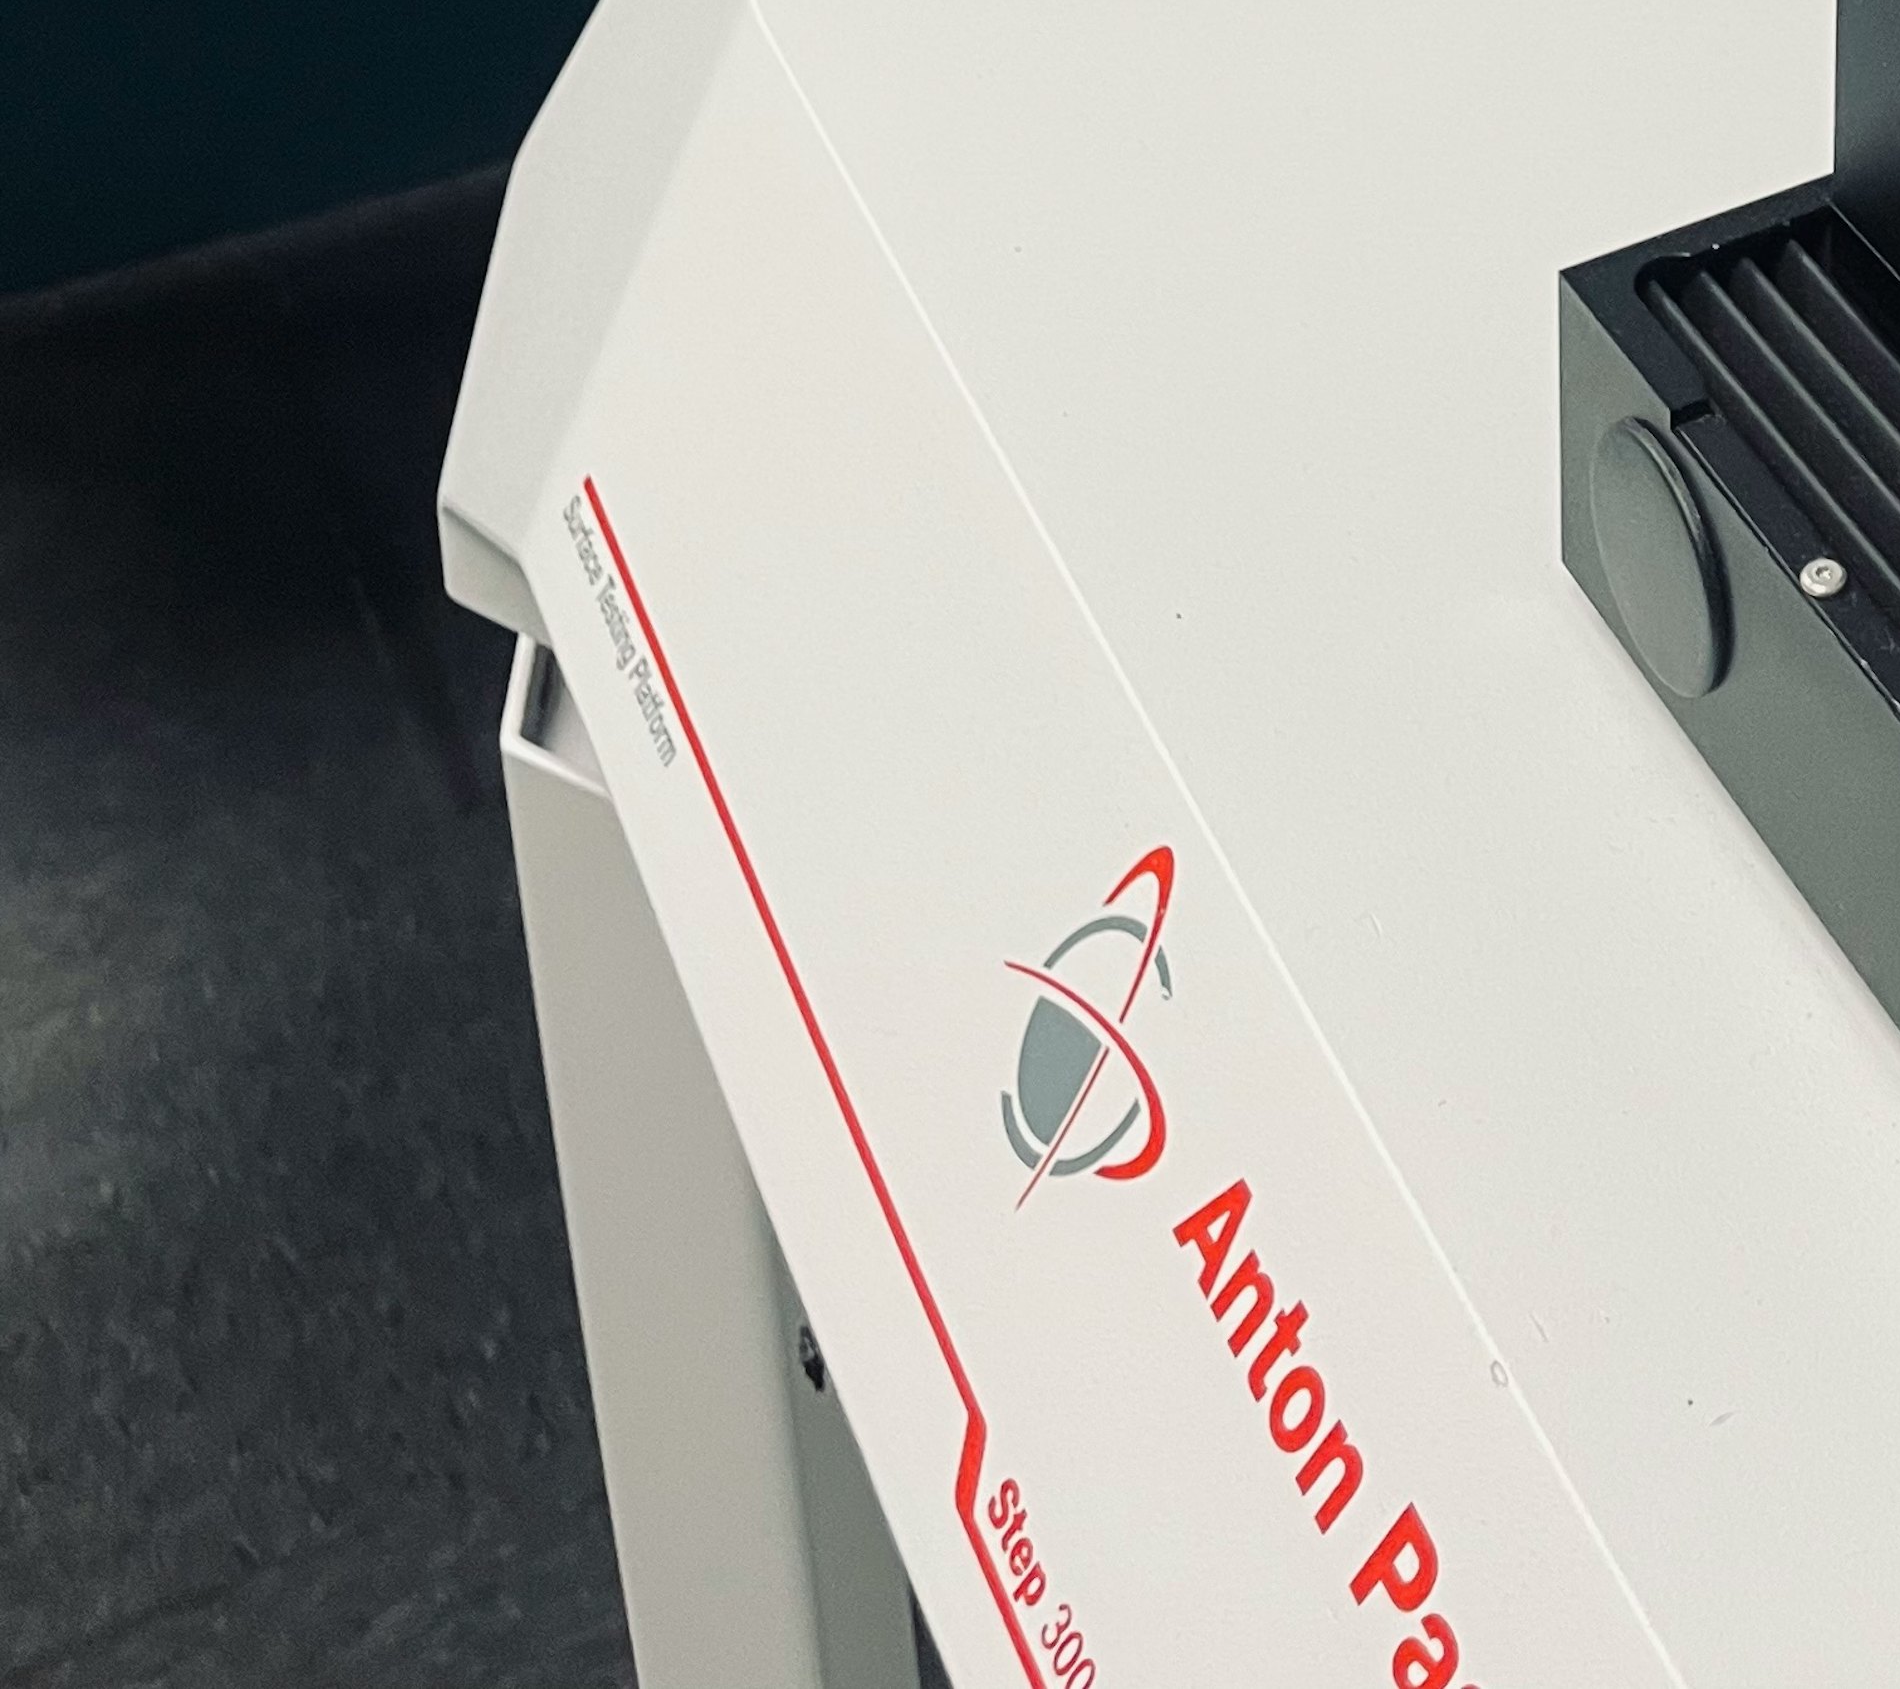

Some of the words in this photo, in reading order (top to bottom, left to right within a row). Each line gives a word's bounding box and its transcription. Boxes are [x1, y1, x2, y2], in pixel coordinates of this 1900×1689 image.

[562, 494, 603, 586] Surface
[595, 573, 638, 672] Testing
[628, 657, 678, 768] Platform
[1172, 1177, 1364, 1536] Anton
[1348, 1501, 1482, 1689] Pa
[988, 1477, 1047, 1607] Step
[1041, 1603, 1096, 1689] 300
